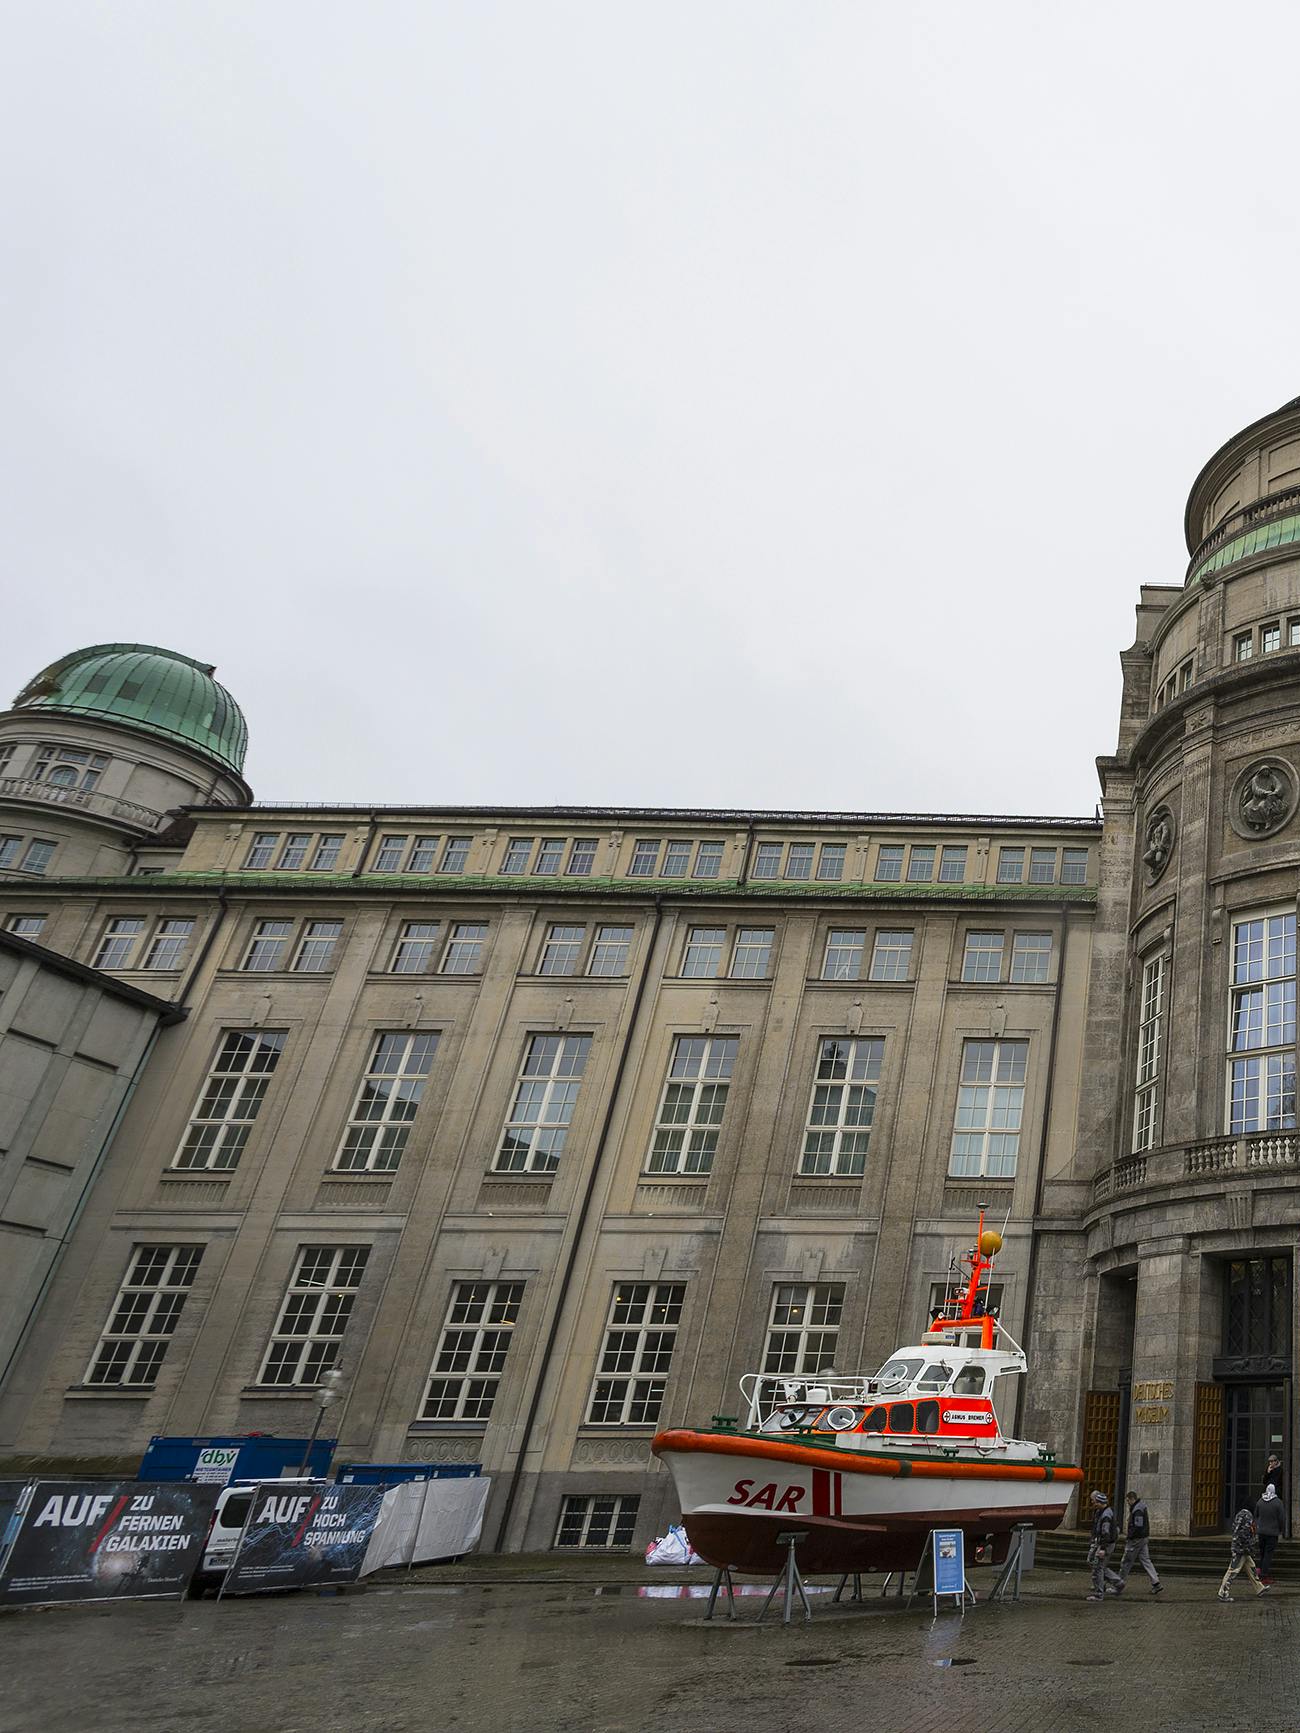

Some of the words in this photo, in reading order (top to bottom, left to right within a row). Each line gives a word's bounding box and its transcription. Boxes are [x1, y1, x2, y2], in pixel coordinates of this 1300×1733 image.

[201, 1449, 236, 1466] dbv
[130, 1495, 155, 1511] ZU
[320, 1496, 338, 1510] ZU
[727, 1479, 806, 1513] SAR
[34, 1495, 114, 1527] AUF
[256, 1496, 311, 1523] AUF
[118, 1515, 184, 1532] FERNEN
[312, 1513, 347, 1527] HOCH
[106, 1534, 191, 1552] GALAXIEN
[303, 1530, 366, 1546] SPANNUNG
